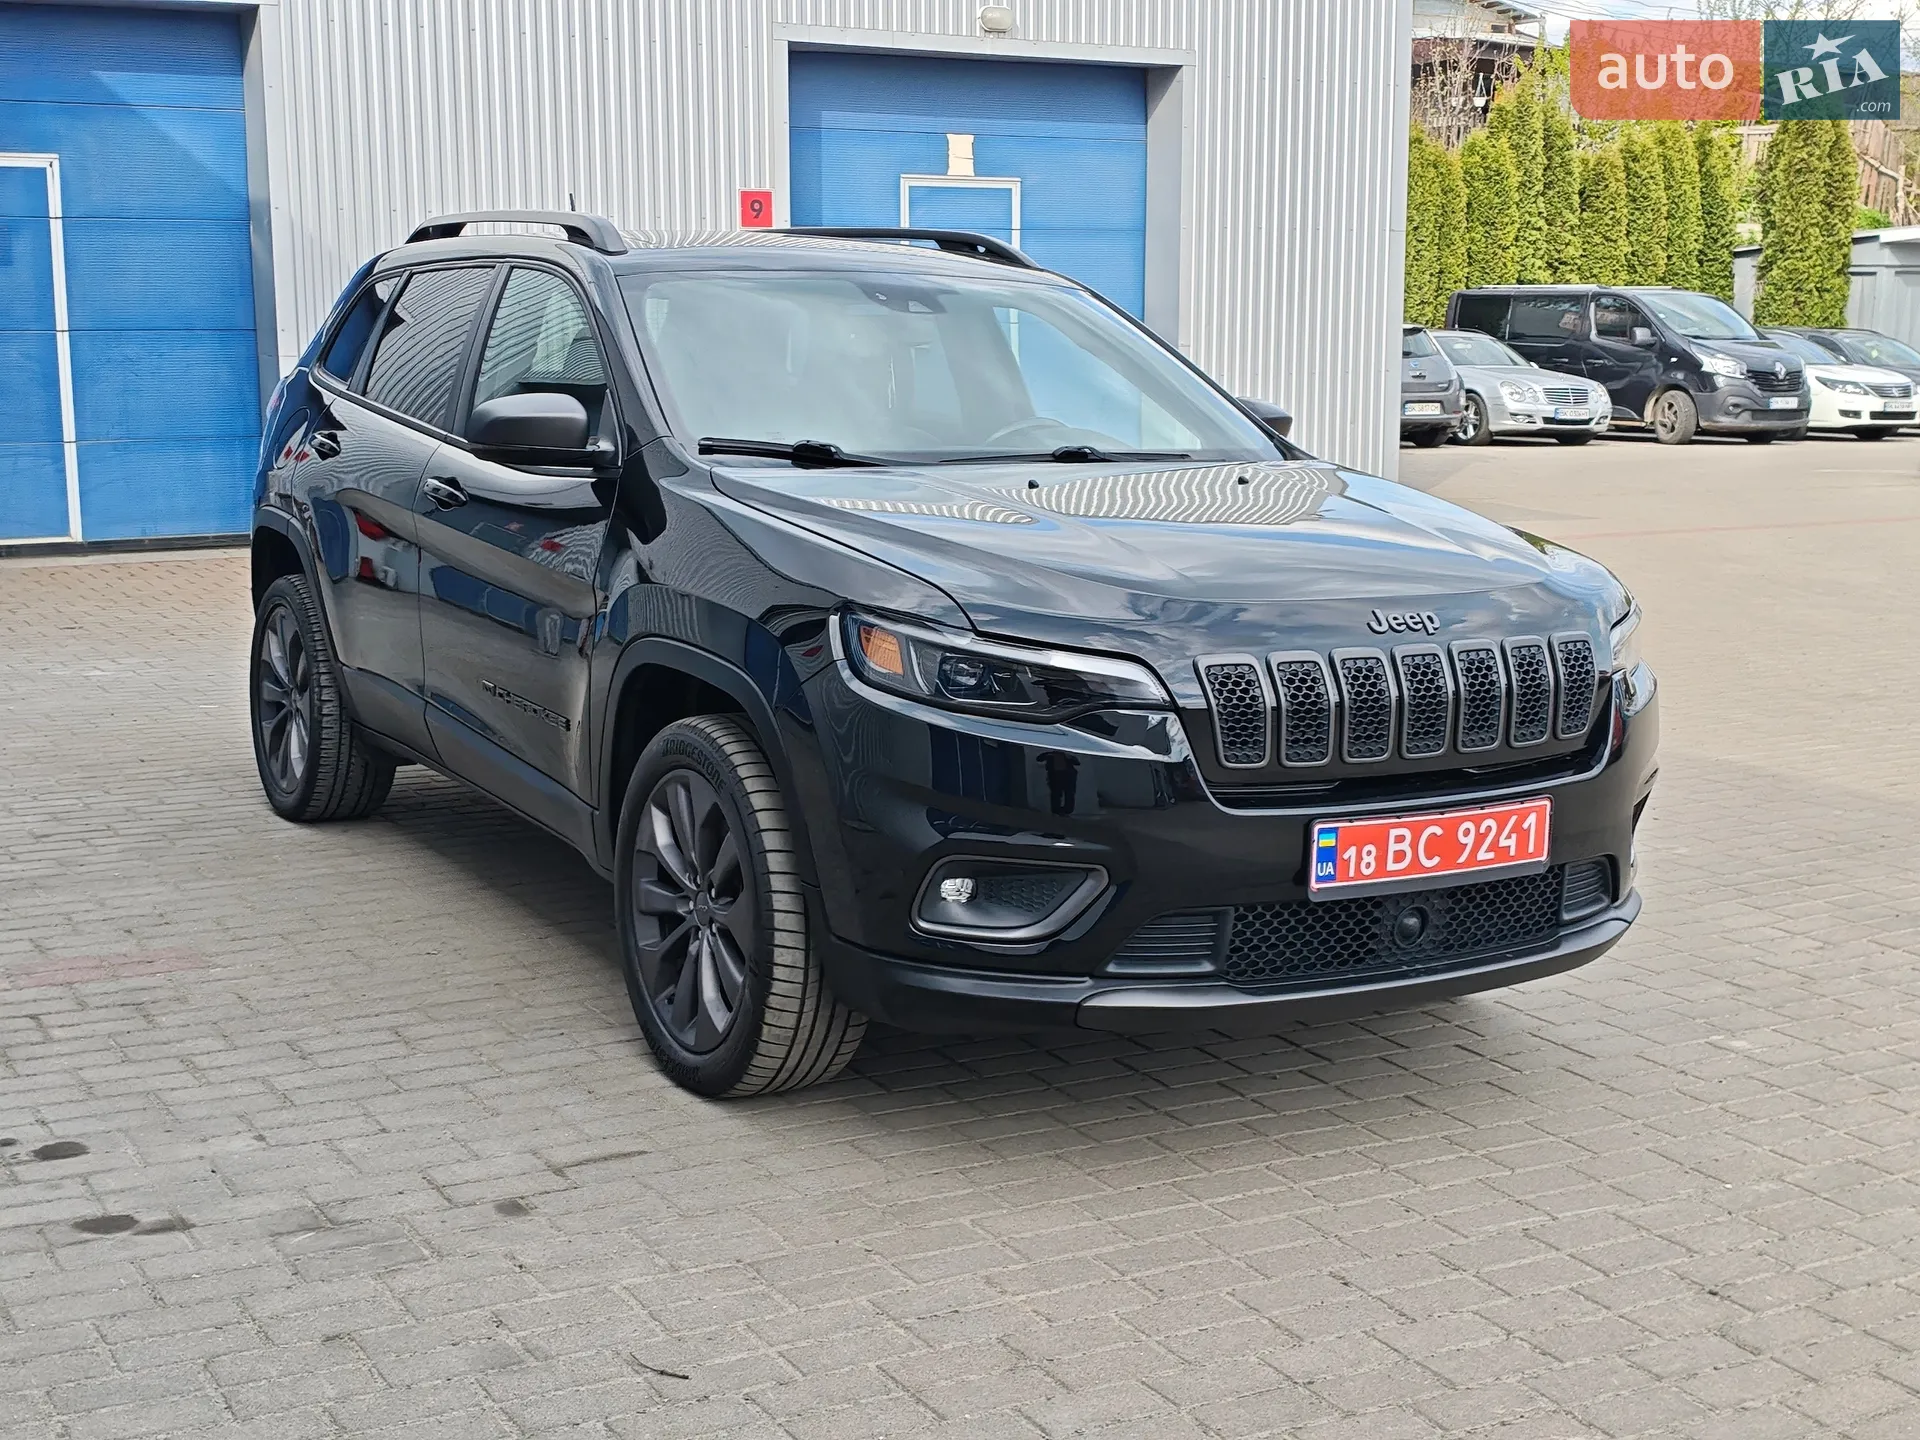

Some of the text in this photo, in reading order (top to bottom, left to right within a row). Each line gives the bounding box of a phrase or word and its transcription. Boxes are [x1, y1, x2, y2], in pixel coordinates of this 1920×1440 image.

[750, 199, 763, 219] 9
[1366, 608, 1440, 636] Jeep
[1342, 812, 1537, 878] 18 BC 9241
[1317, 861, 1335, 877] UA
